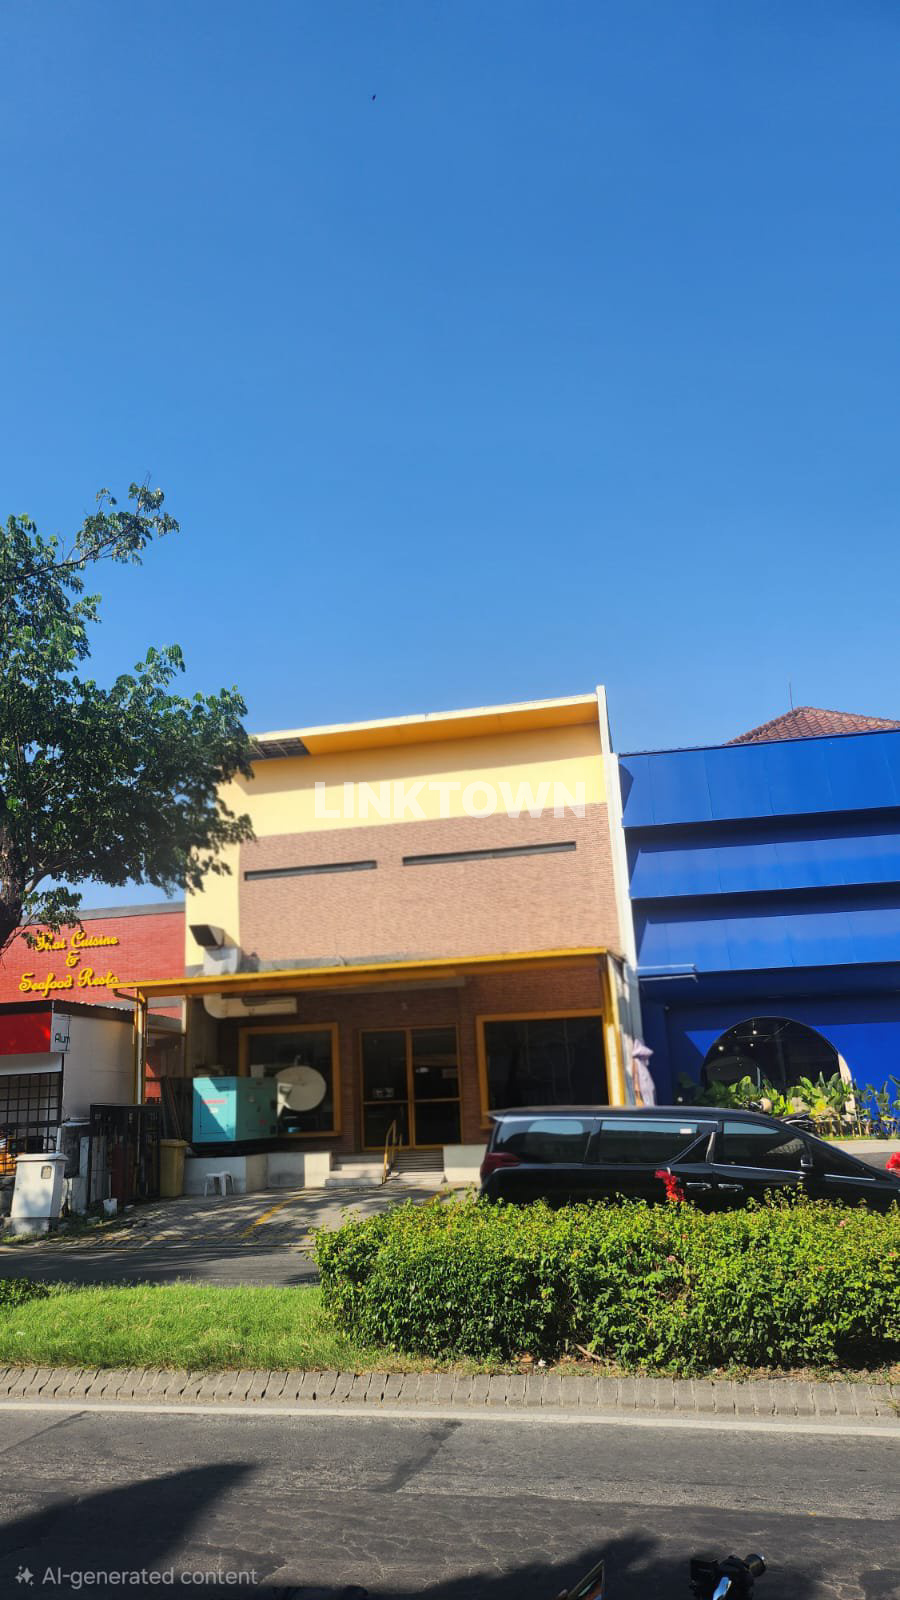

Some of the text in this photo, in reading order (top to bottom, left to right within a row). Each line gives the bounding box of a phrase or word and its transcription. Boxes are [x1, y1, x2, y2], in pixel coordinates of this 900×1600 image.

[70, 930, 118, 949] Cuisine
[65, 950, 80, 967] &
[19, 967, 119, 997] Seafood Resto
